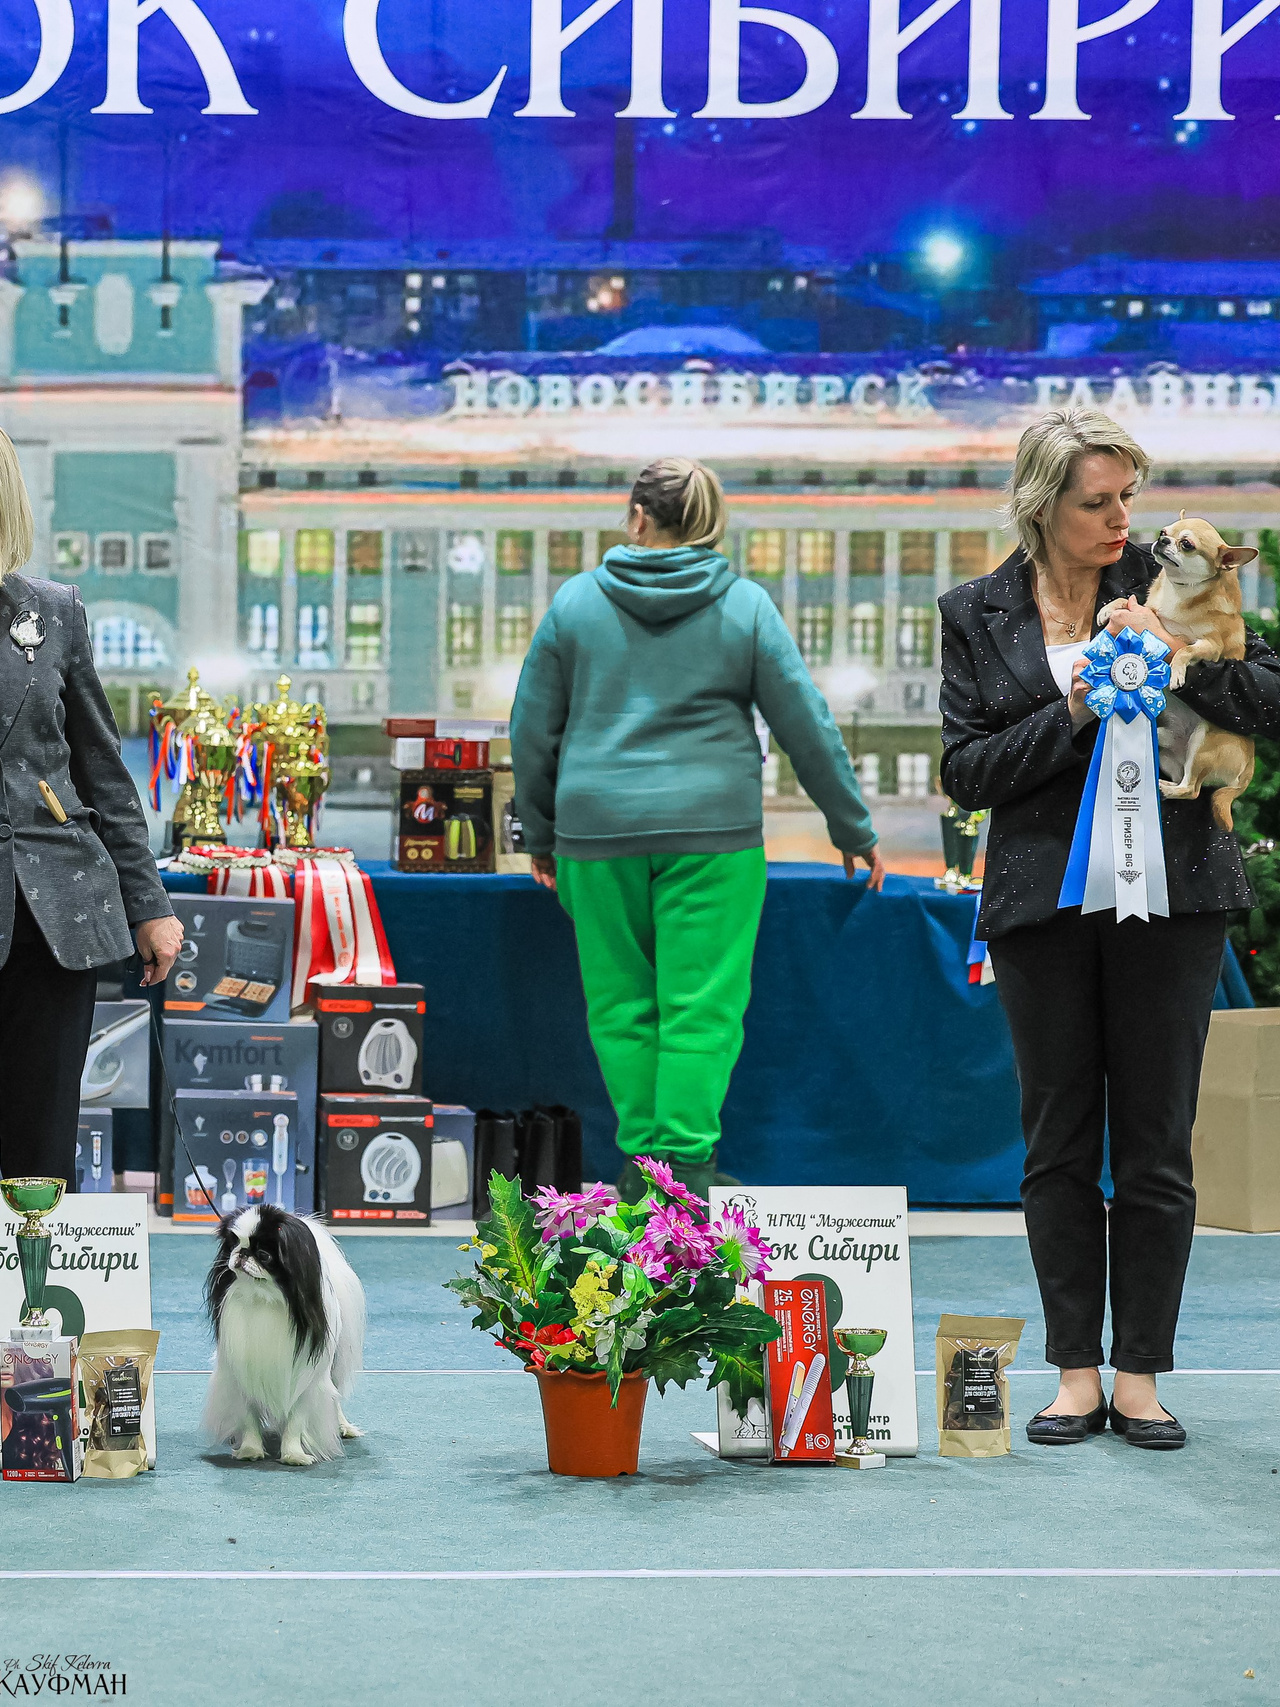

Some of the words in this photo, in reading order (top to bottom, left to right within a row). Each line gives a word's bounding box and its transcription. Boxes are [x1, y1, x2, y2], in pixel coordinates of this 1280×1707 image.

[448, 373, 936, 416] НОВОСИБИРСК
[48, 1244, 139, 1282] Сибири
[808, 1235, 901, 1273] Сибири
[779, 1289, 793, 1302] 25
[832, 1413, 890, 1425] Зоонтр
